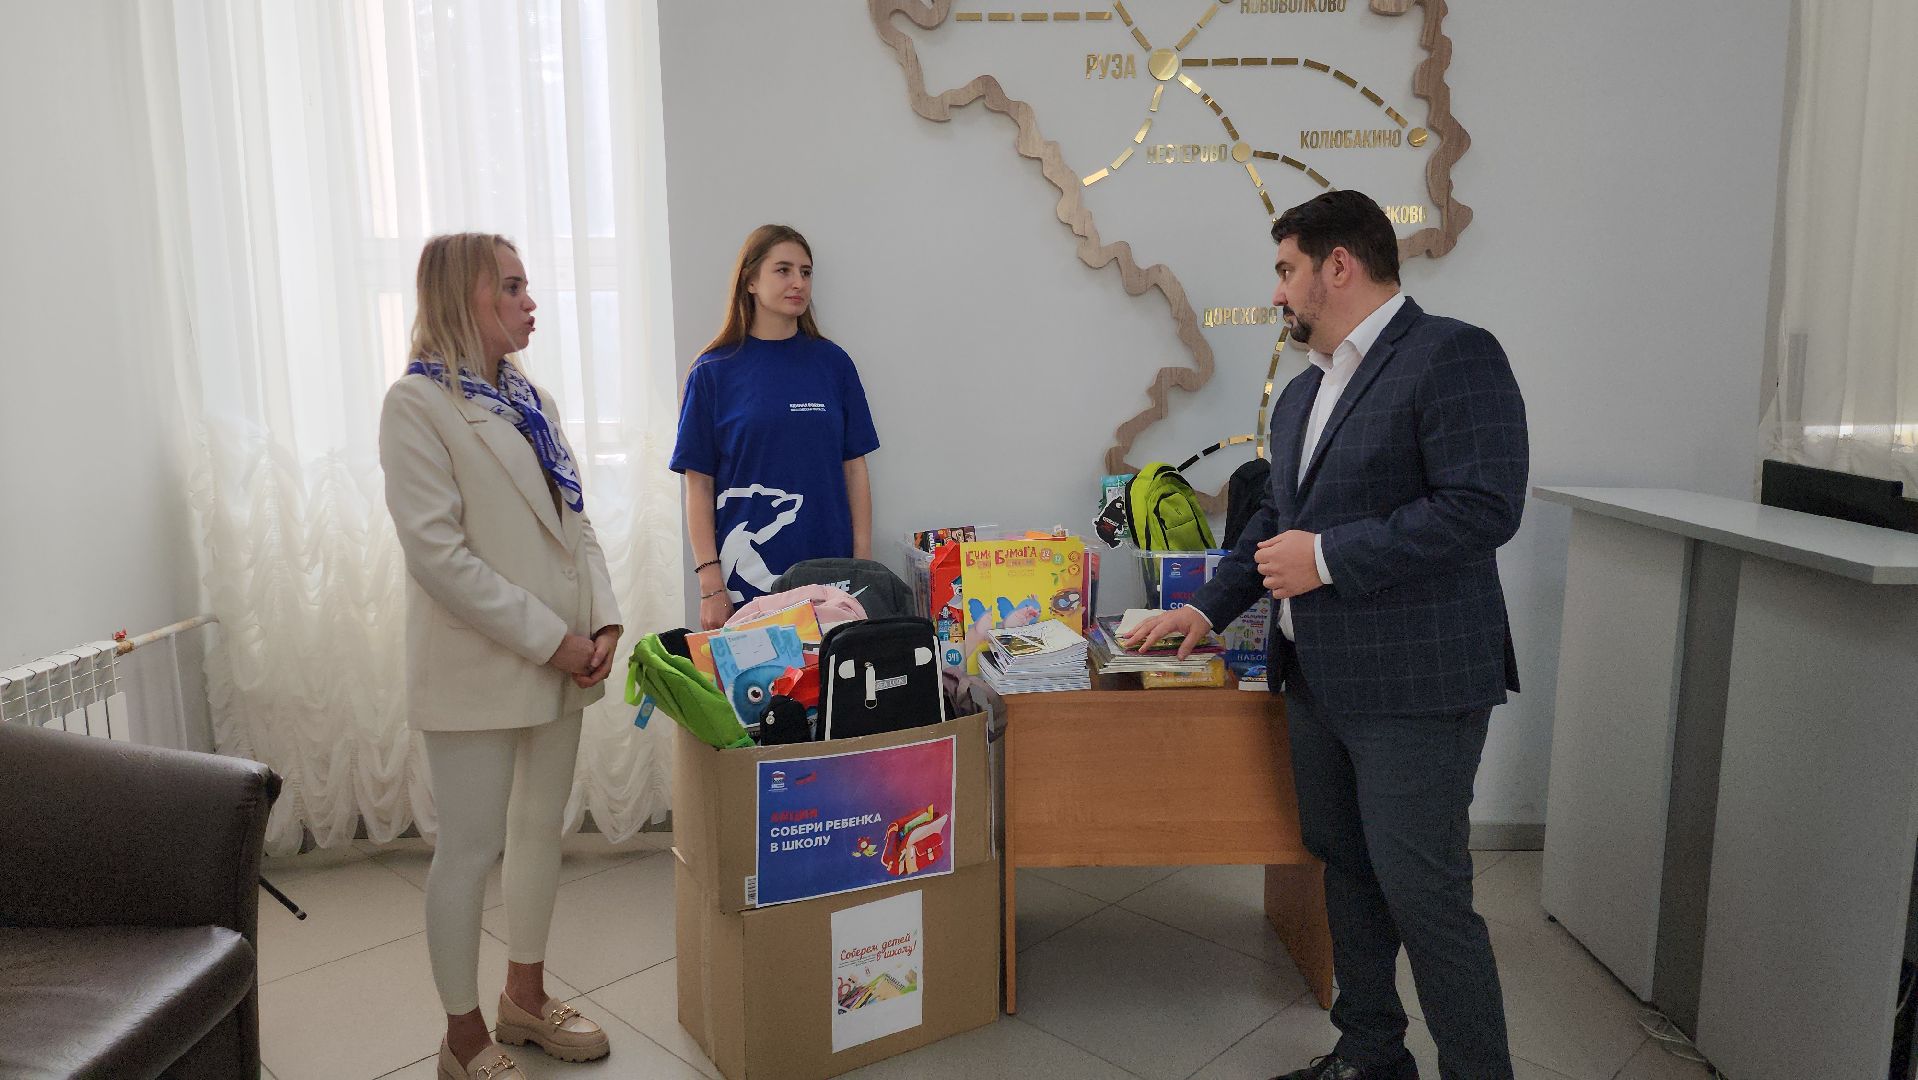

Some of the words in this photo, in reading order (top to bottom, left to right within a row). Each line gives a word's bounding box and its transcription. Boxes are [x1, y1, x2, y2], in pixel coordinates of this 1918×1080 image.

[1086, 53, 1137, 80] РУЗА
[1300, 129, 1402, 149] КОЛЮБАКИНО
[1146, 144, 1229, 164] НЕСТЕРОВО
[1203, 306, 1278, 328] ДОРОХОВО
[770, 821, 823, 838] СОБЕРИ
[825, 812, 882, 831] РЕБЕНКА
[770, 842, 779, 853] В
[782, 834, 831, 851] ШКОЛУ
[840, 943, 879, 961] Соберем
[881, 932, 911, 953] детей
